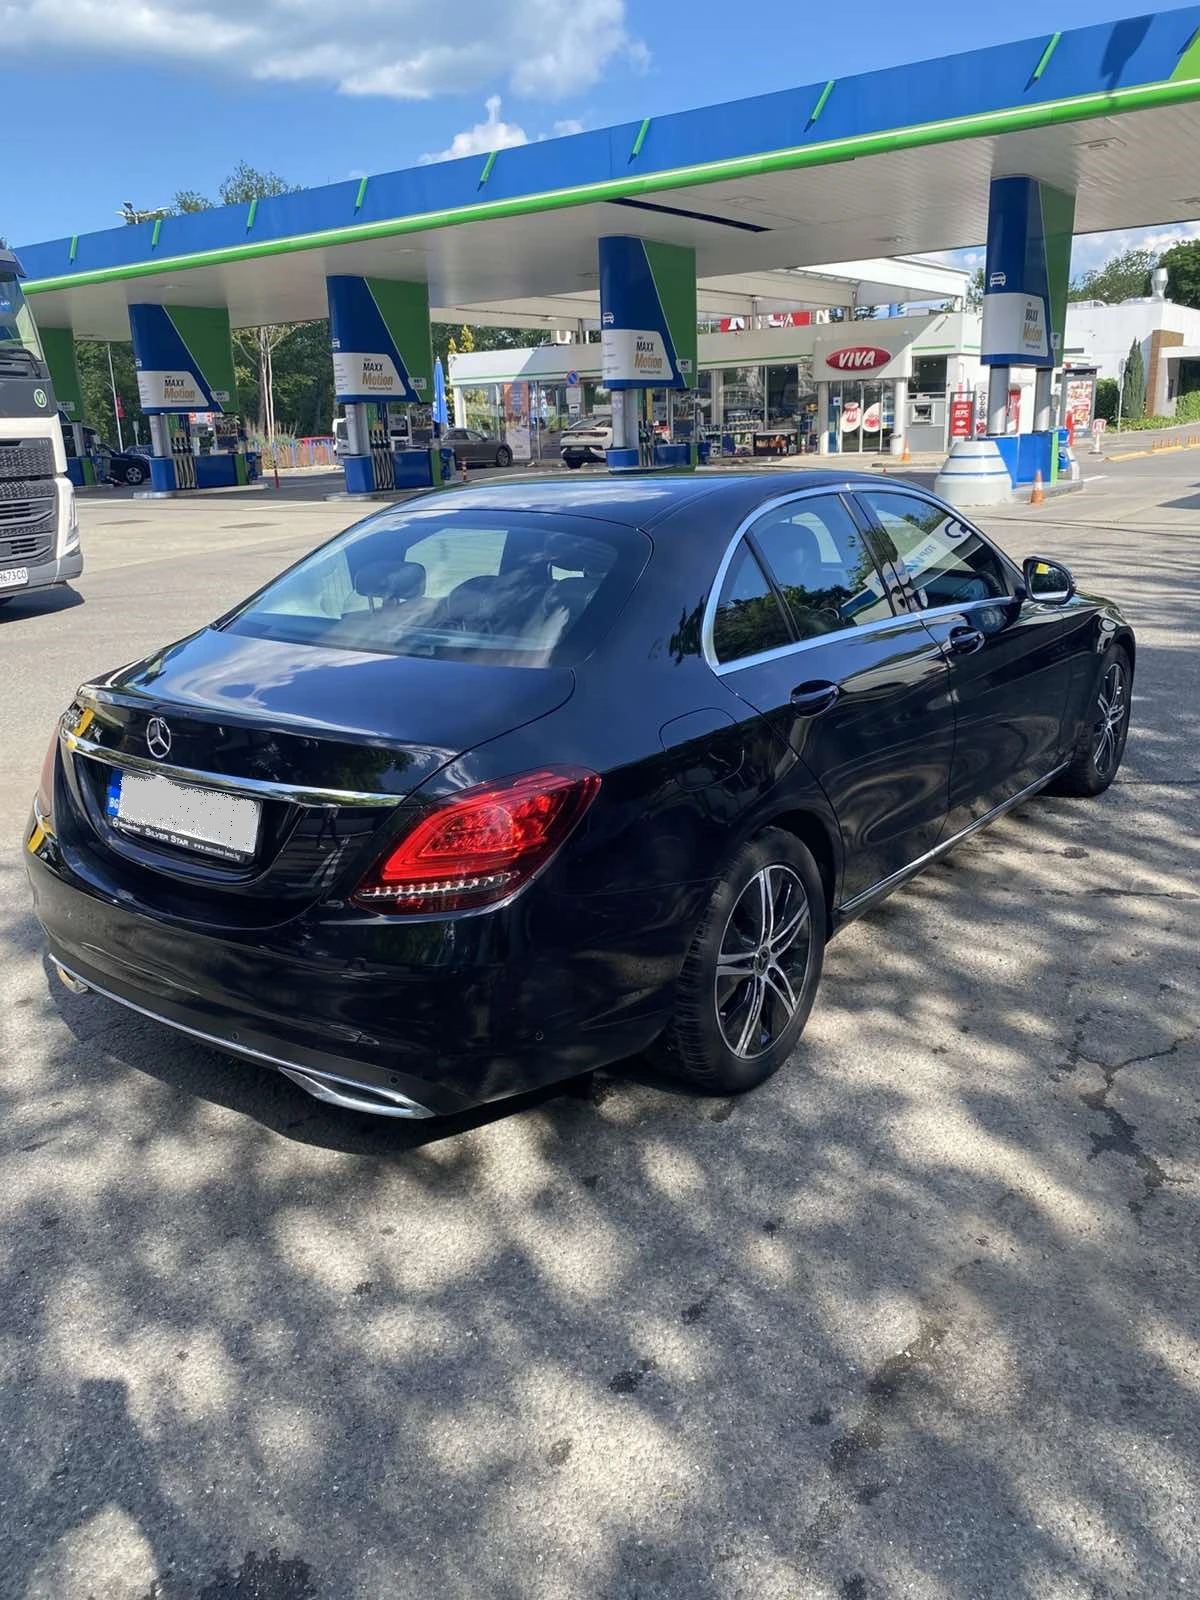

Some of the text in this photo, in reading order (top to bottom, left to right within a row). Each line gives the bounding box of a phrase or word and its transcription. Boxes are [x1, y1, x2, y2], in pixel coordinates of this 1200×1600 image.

[636, 341, 655, 352] MAXX
[634, 352, 663, 369] Motion
[838, 351, 876, 367] VIVA
[362, 362, 383, 371] MAXX
[164, 379, 184, 387] MAXX
[362, 372, 393, 386] Motion
[163, 387, 196, 400] Motion
[109, 797, 119, 809] BG
[170, 835, 189, 847] STAR
